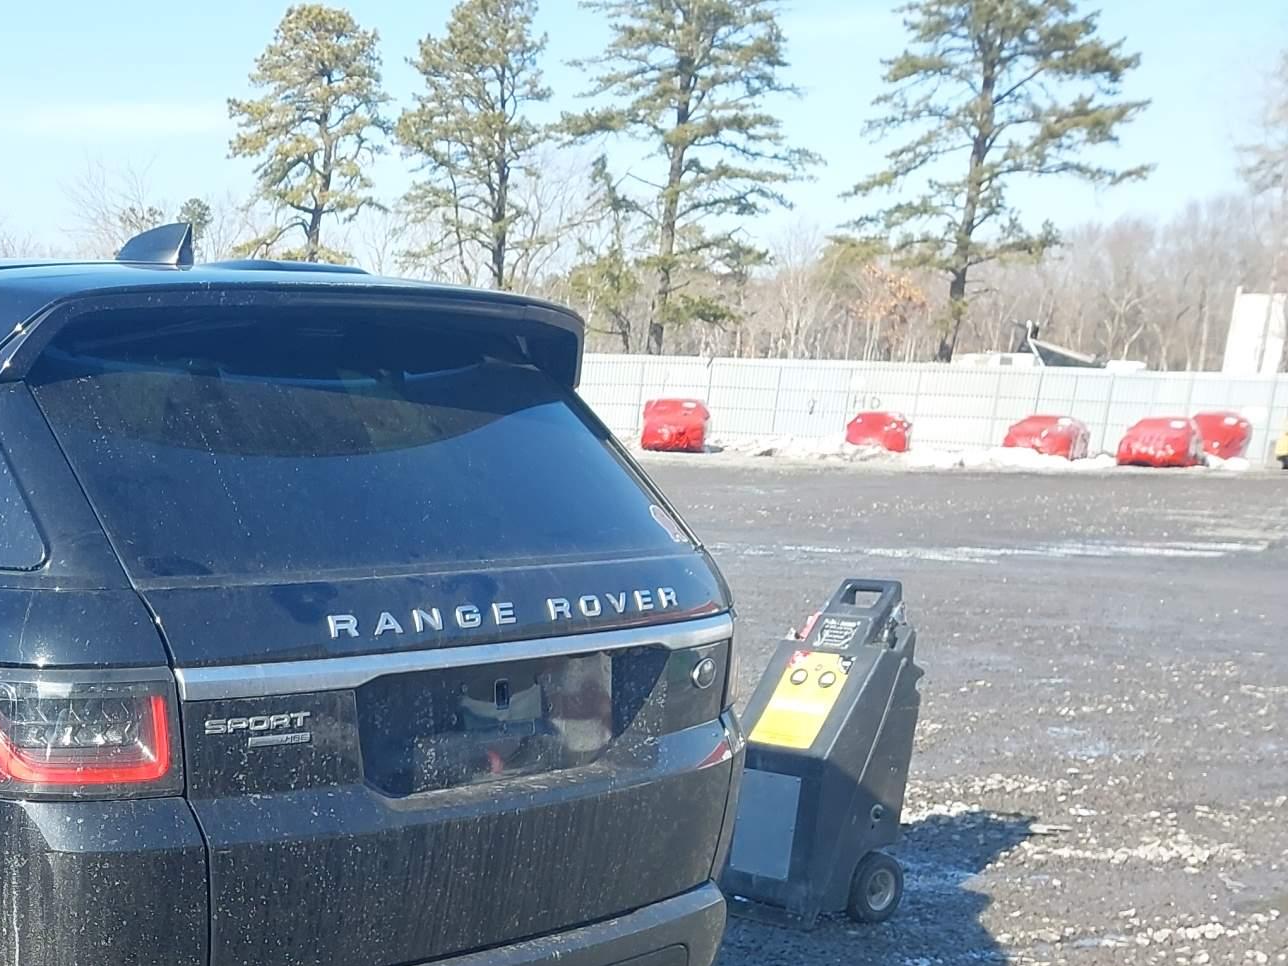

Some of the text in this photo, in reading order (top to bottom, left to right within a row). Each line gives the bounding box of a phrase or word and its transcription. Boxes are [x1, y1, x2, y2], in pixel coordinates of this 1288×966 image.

[327, 586, 679, 639] RANGE ROVER
[204, 711, 311, 735] SPORT
